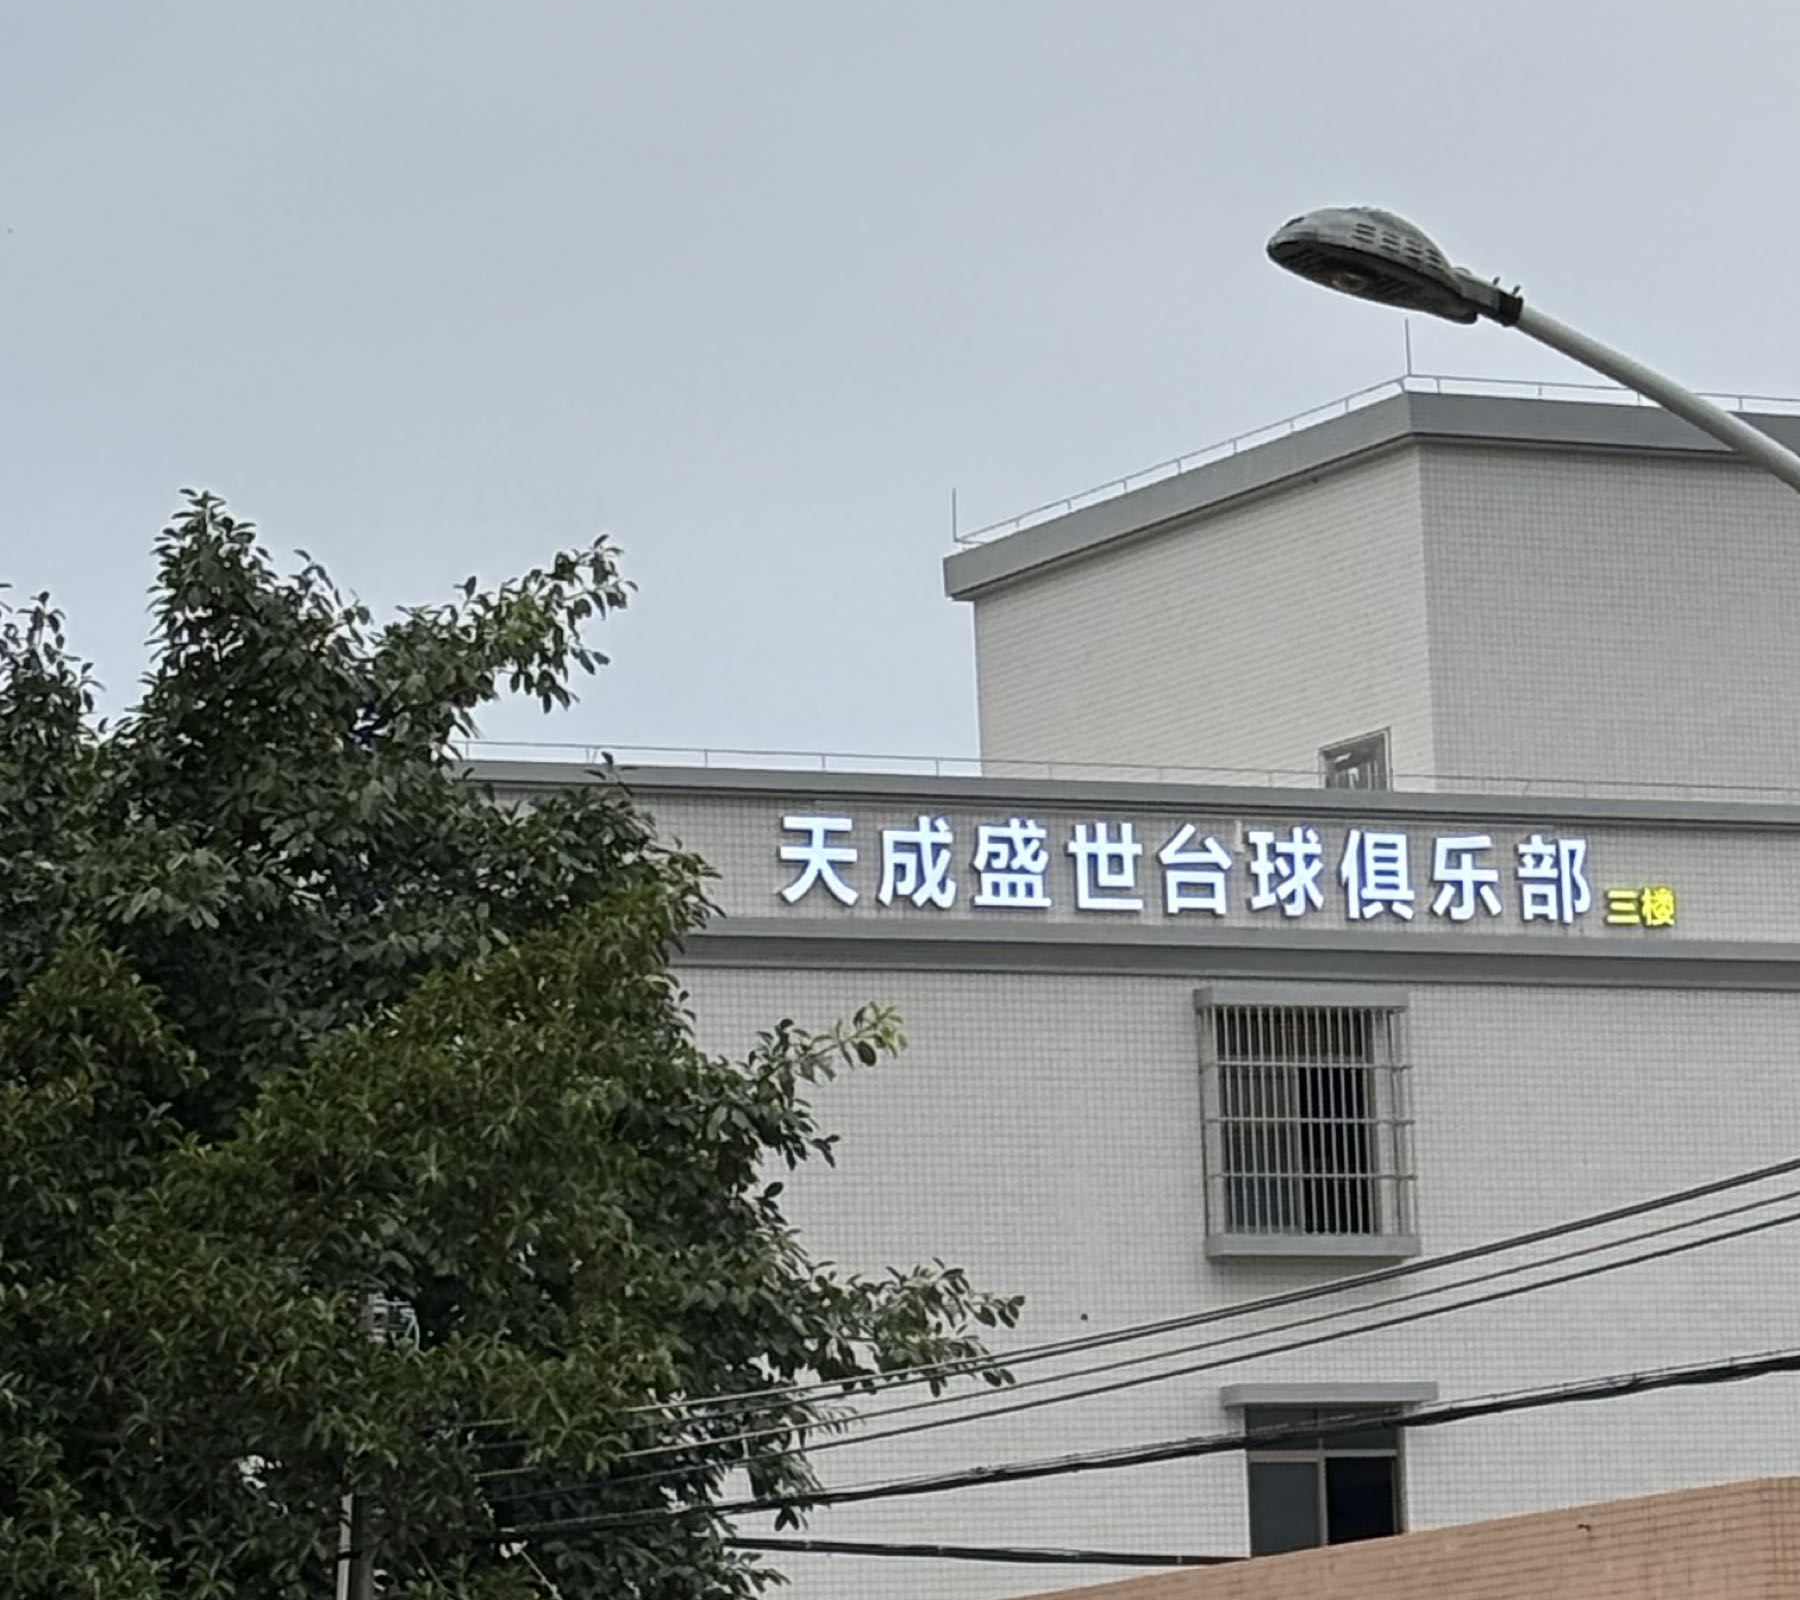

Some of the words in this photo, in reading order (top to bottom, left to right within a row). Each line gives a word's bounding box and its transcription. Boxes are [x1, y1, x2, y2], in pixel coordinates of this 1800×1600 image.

[777, 813, 1592, 926] 天成盛世台球俱乐部
[1606, 886, 1675, 927] 三楼
